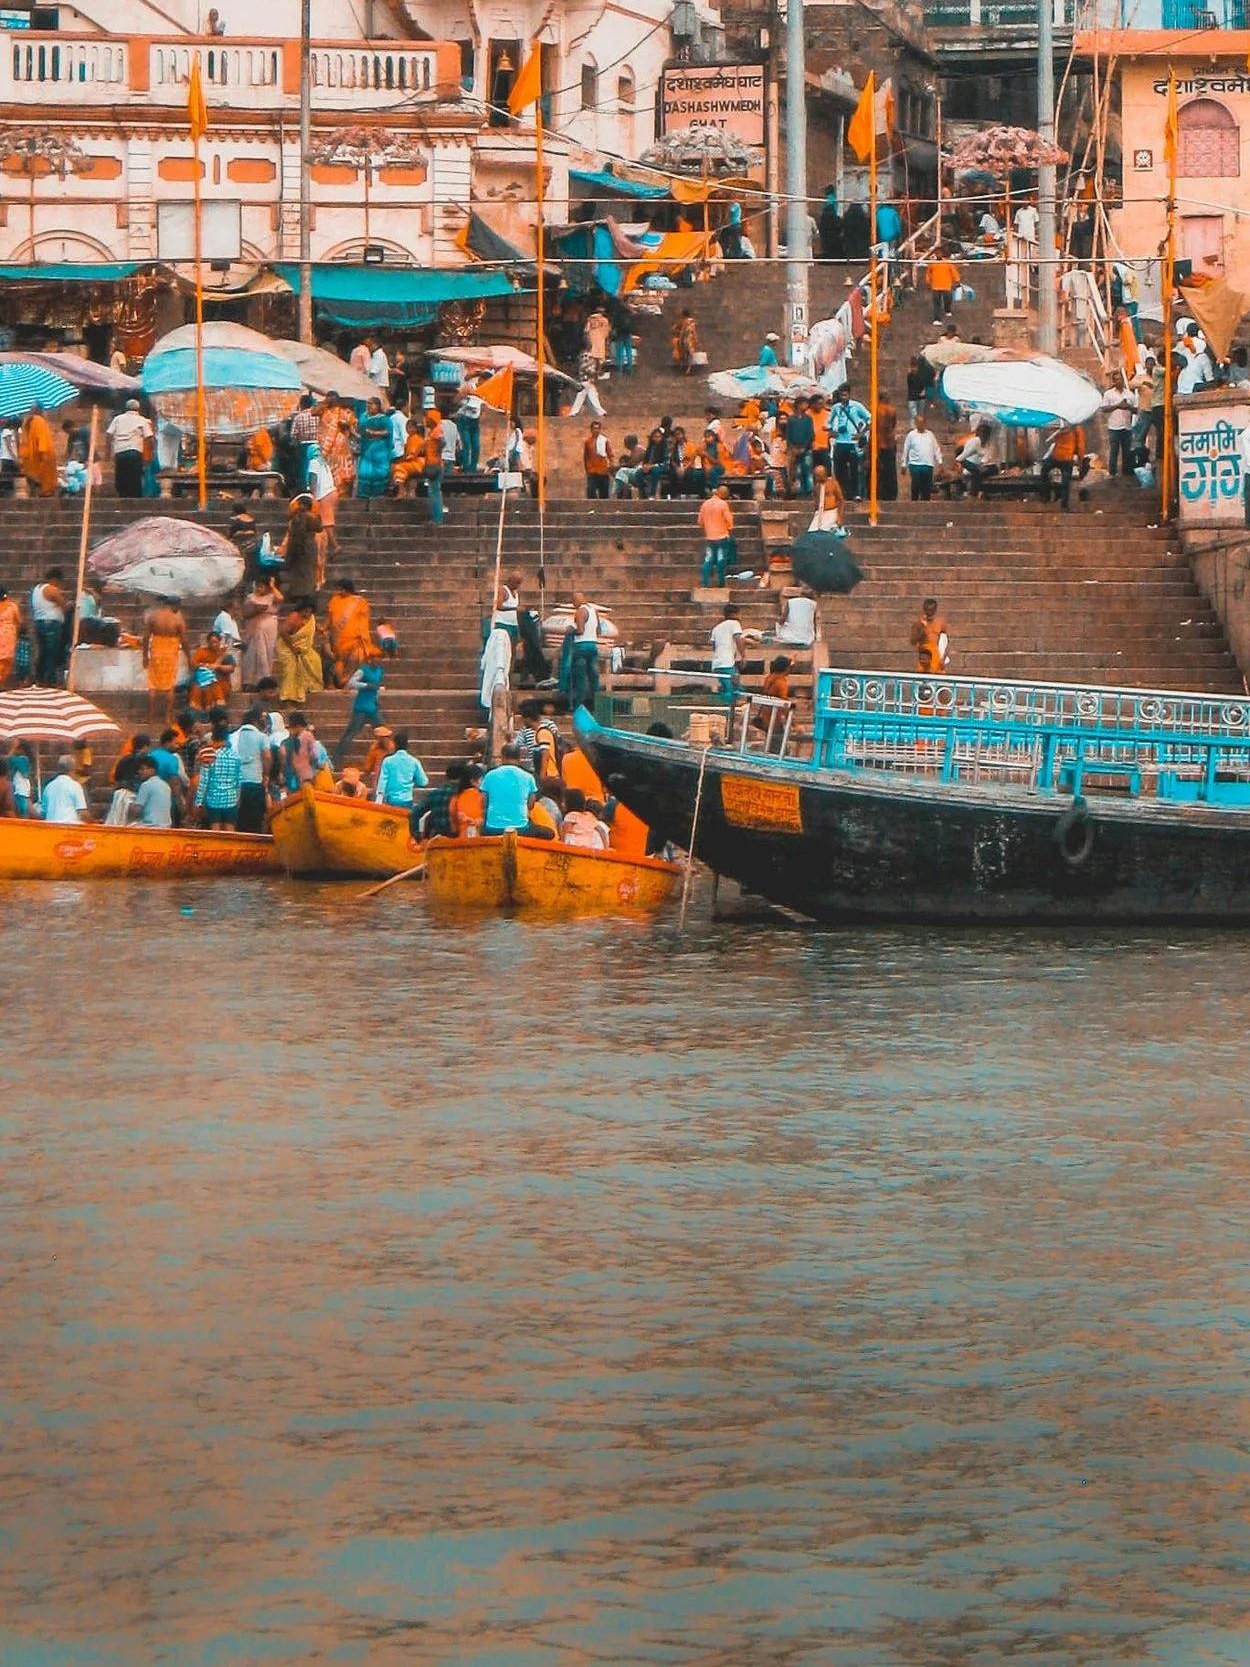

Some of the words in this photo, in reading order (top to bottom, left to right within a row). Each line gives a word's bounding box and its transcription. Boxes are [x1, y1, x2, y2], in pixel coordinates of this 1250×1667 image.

[737, 75, 762, 88] घाट
[664, 100, 761, 114] DASHASHWMEDH
[1180, 420, 1240, 453] नमामि
